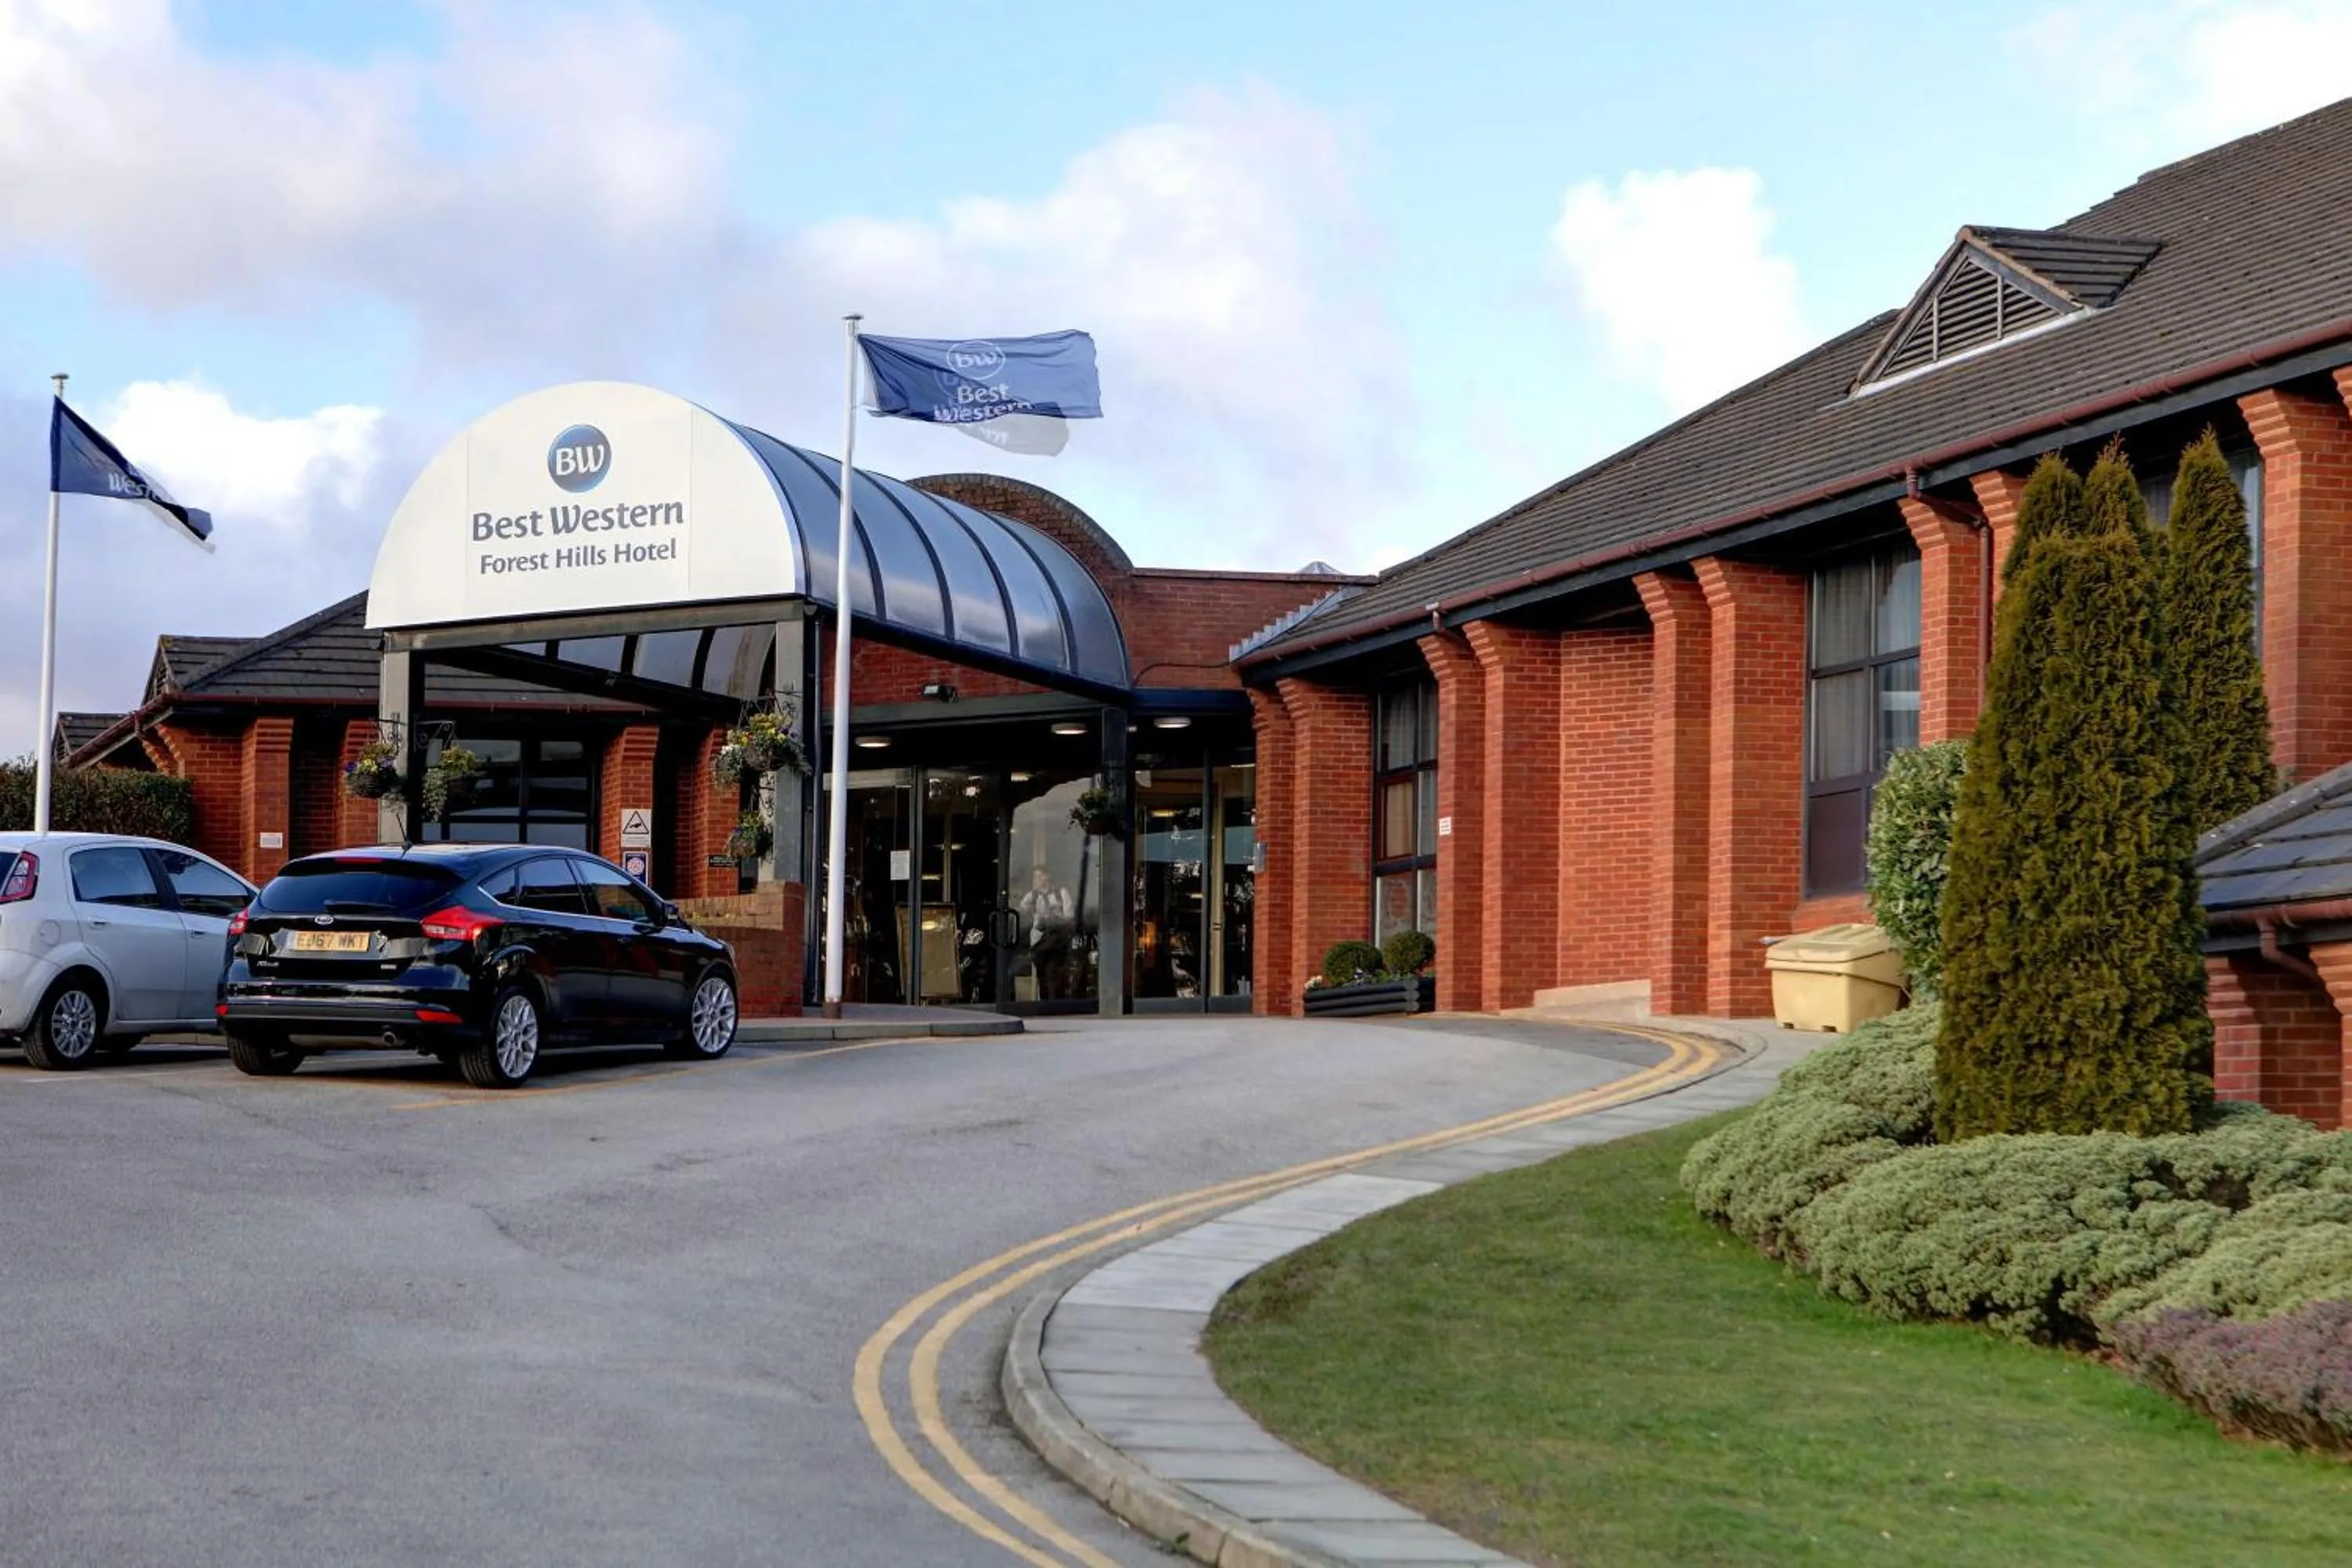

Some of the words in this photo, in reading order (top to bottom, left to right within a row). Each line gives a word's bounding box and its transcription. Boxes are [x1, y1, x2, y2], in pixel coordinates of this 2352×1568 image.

[956, 383, 1010, 405] Best
[933, 401, 1033, 422] Western
[555, 444, 605, 476] BW
[472, 510, 543, 541] Best
[550, 501, 684, 535] Western
[480, 552, 549, 575] Forest
[555, 545, 607, 568] Hills
[614, 538, 677, 563] Hotel
